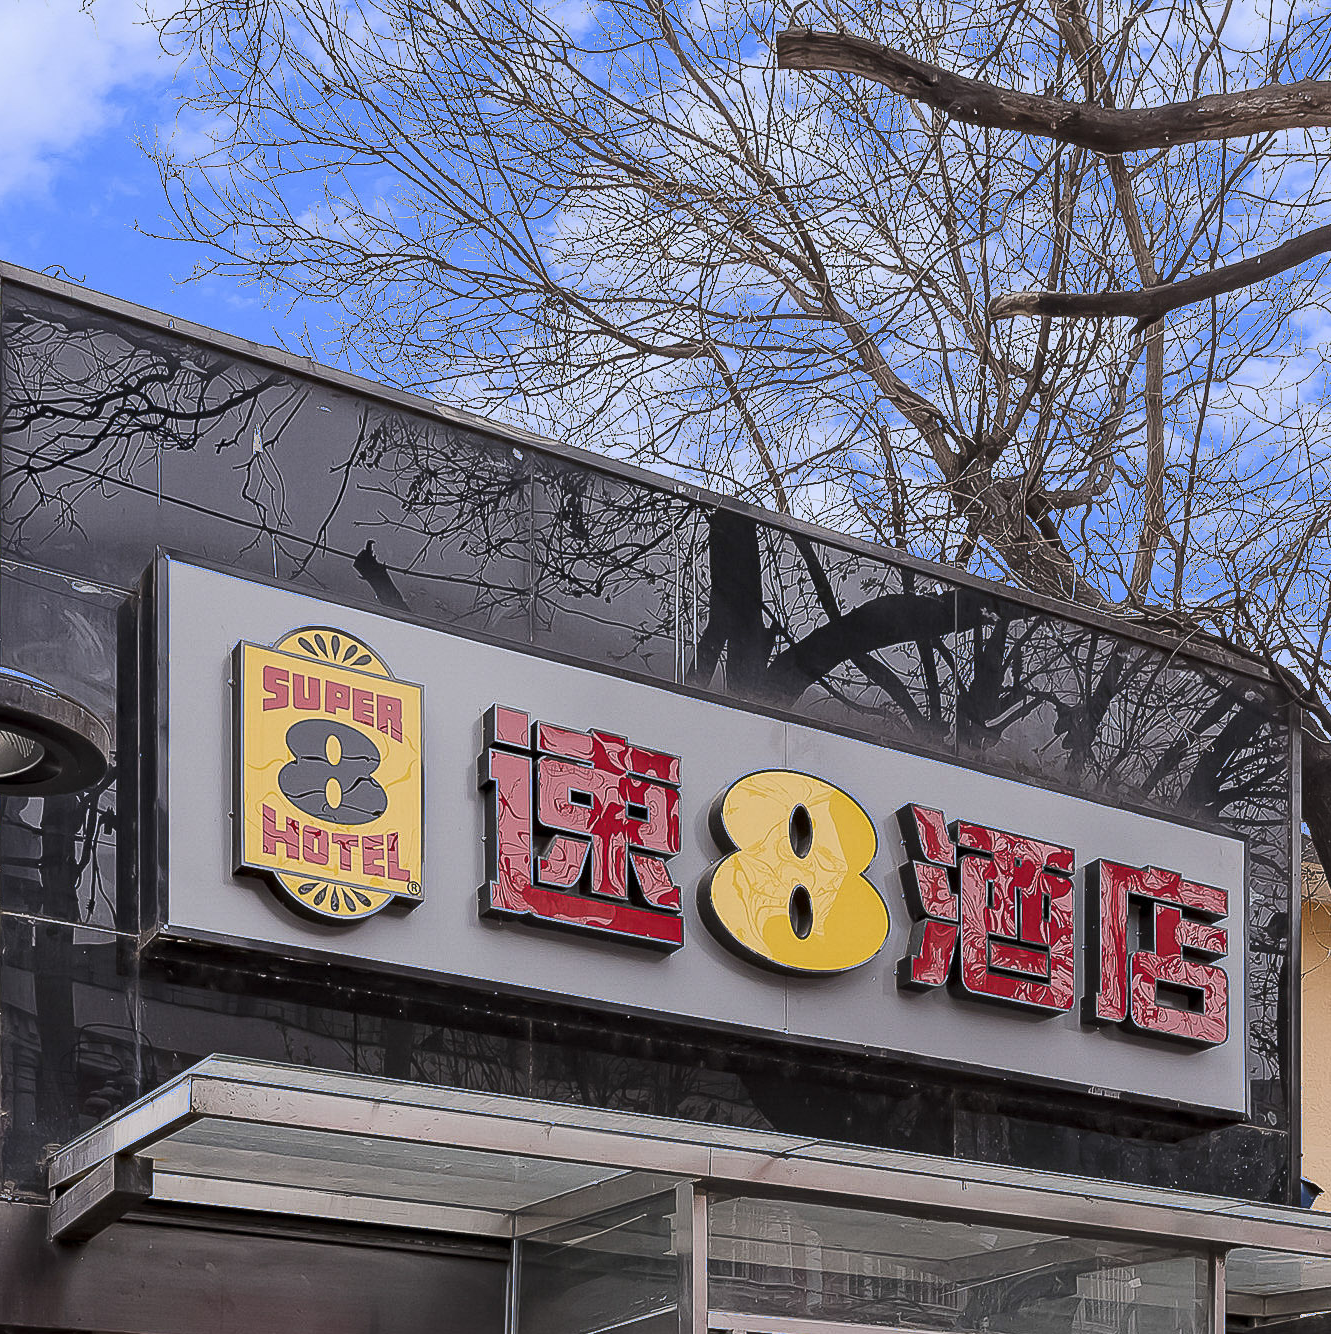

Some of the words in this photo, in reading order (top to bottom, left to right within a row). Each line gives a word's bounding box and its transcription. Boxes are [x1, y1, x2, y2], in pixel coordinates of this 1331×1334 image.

[262, 665, 403, 743] SUPER
[277, 718, 388, 825] 8
[261, 803, 411, 882] HOTEL
[479, 702, 1231, 1048] 速8酒店
